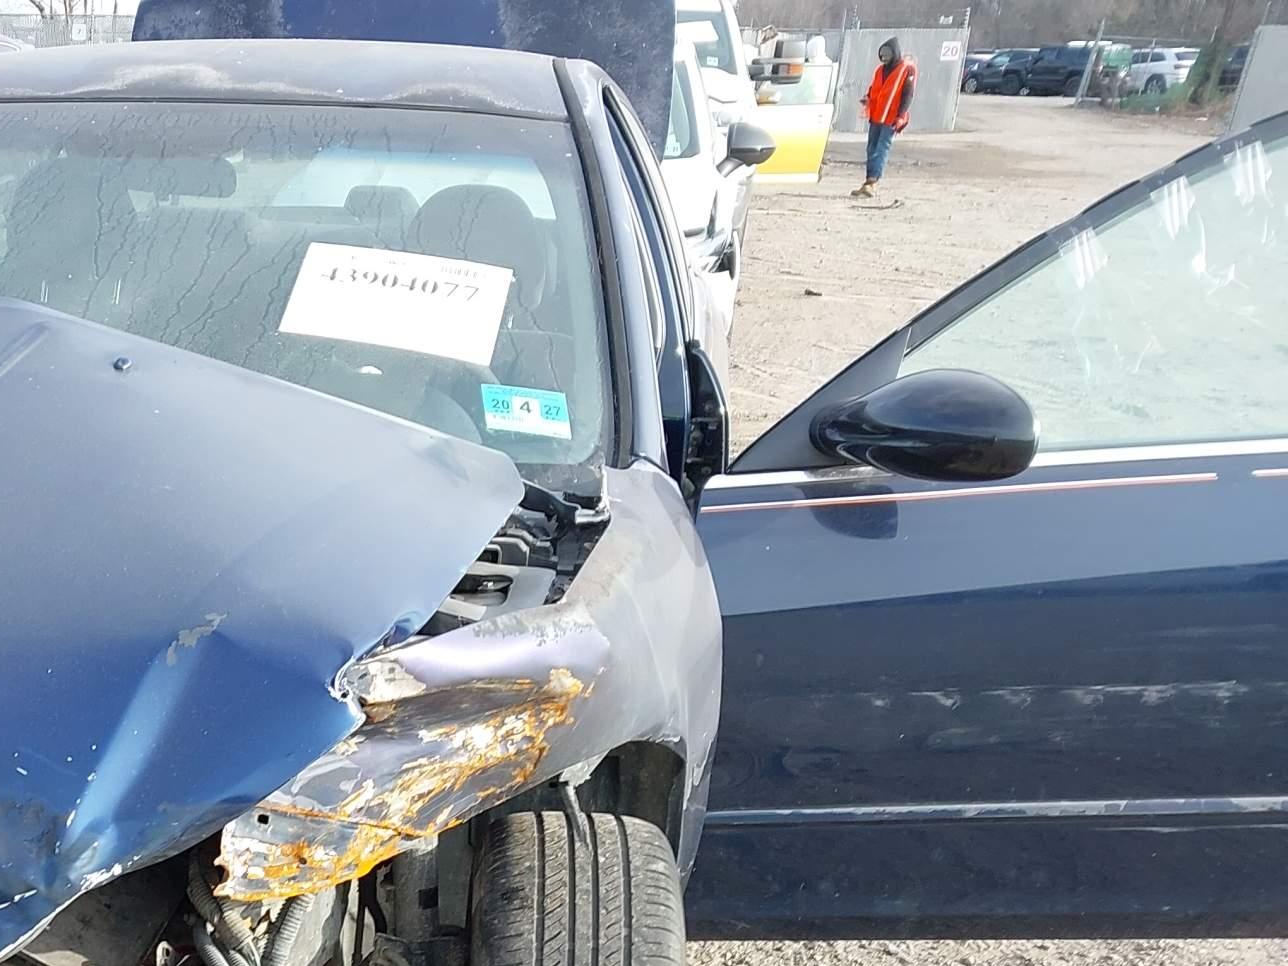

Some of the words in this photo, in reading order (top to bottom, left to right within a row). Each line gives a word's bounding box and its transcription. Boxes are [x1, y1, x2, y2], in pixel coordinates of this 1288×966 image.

[943, 47, 958, 57] 20
[321, 266, 479, 301] 43904077
[492, 399, 510, 410] 20
[519, 400, 532, 413] 4
[544, 404, 561, 416] 27
